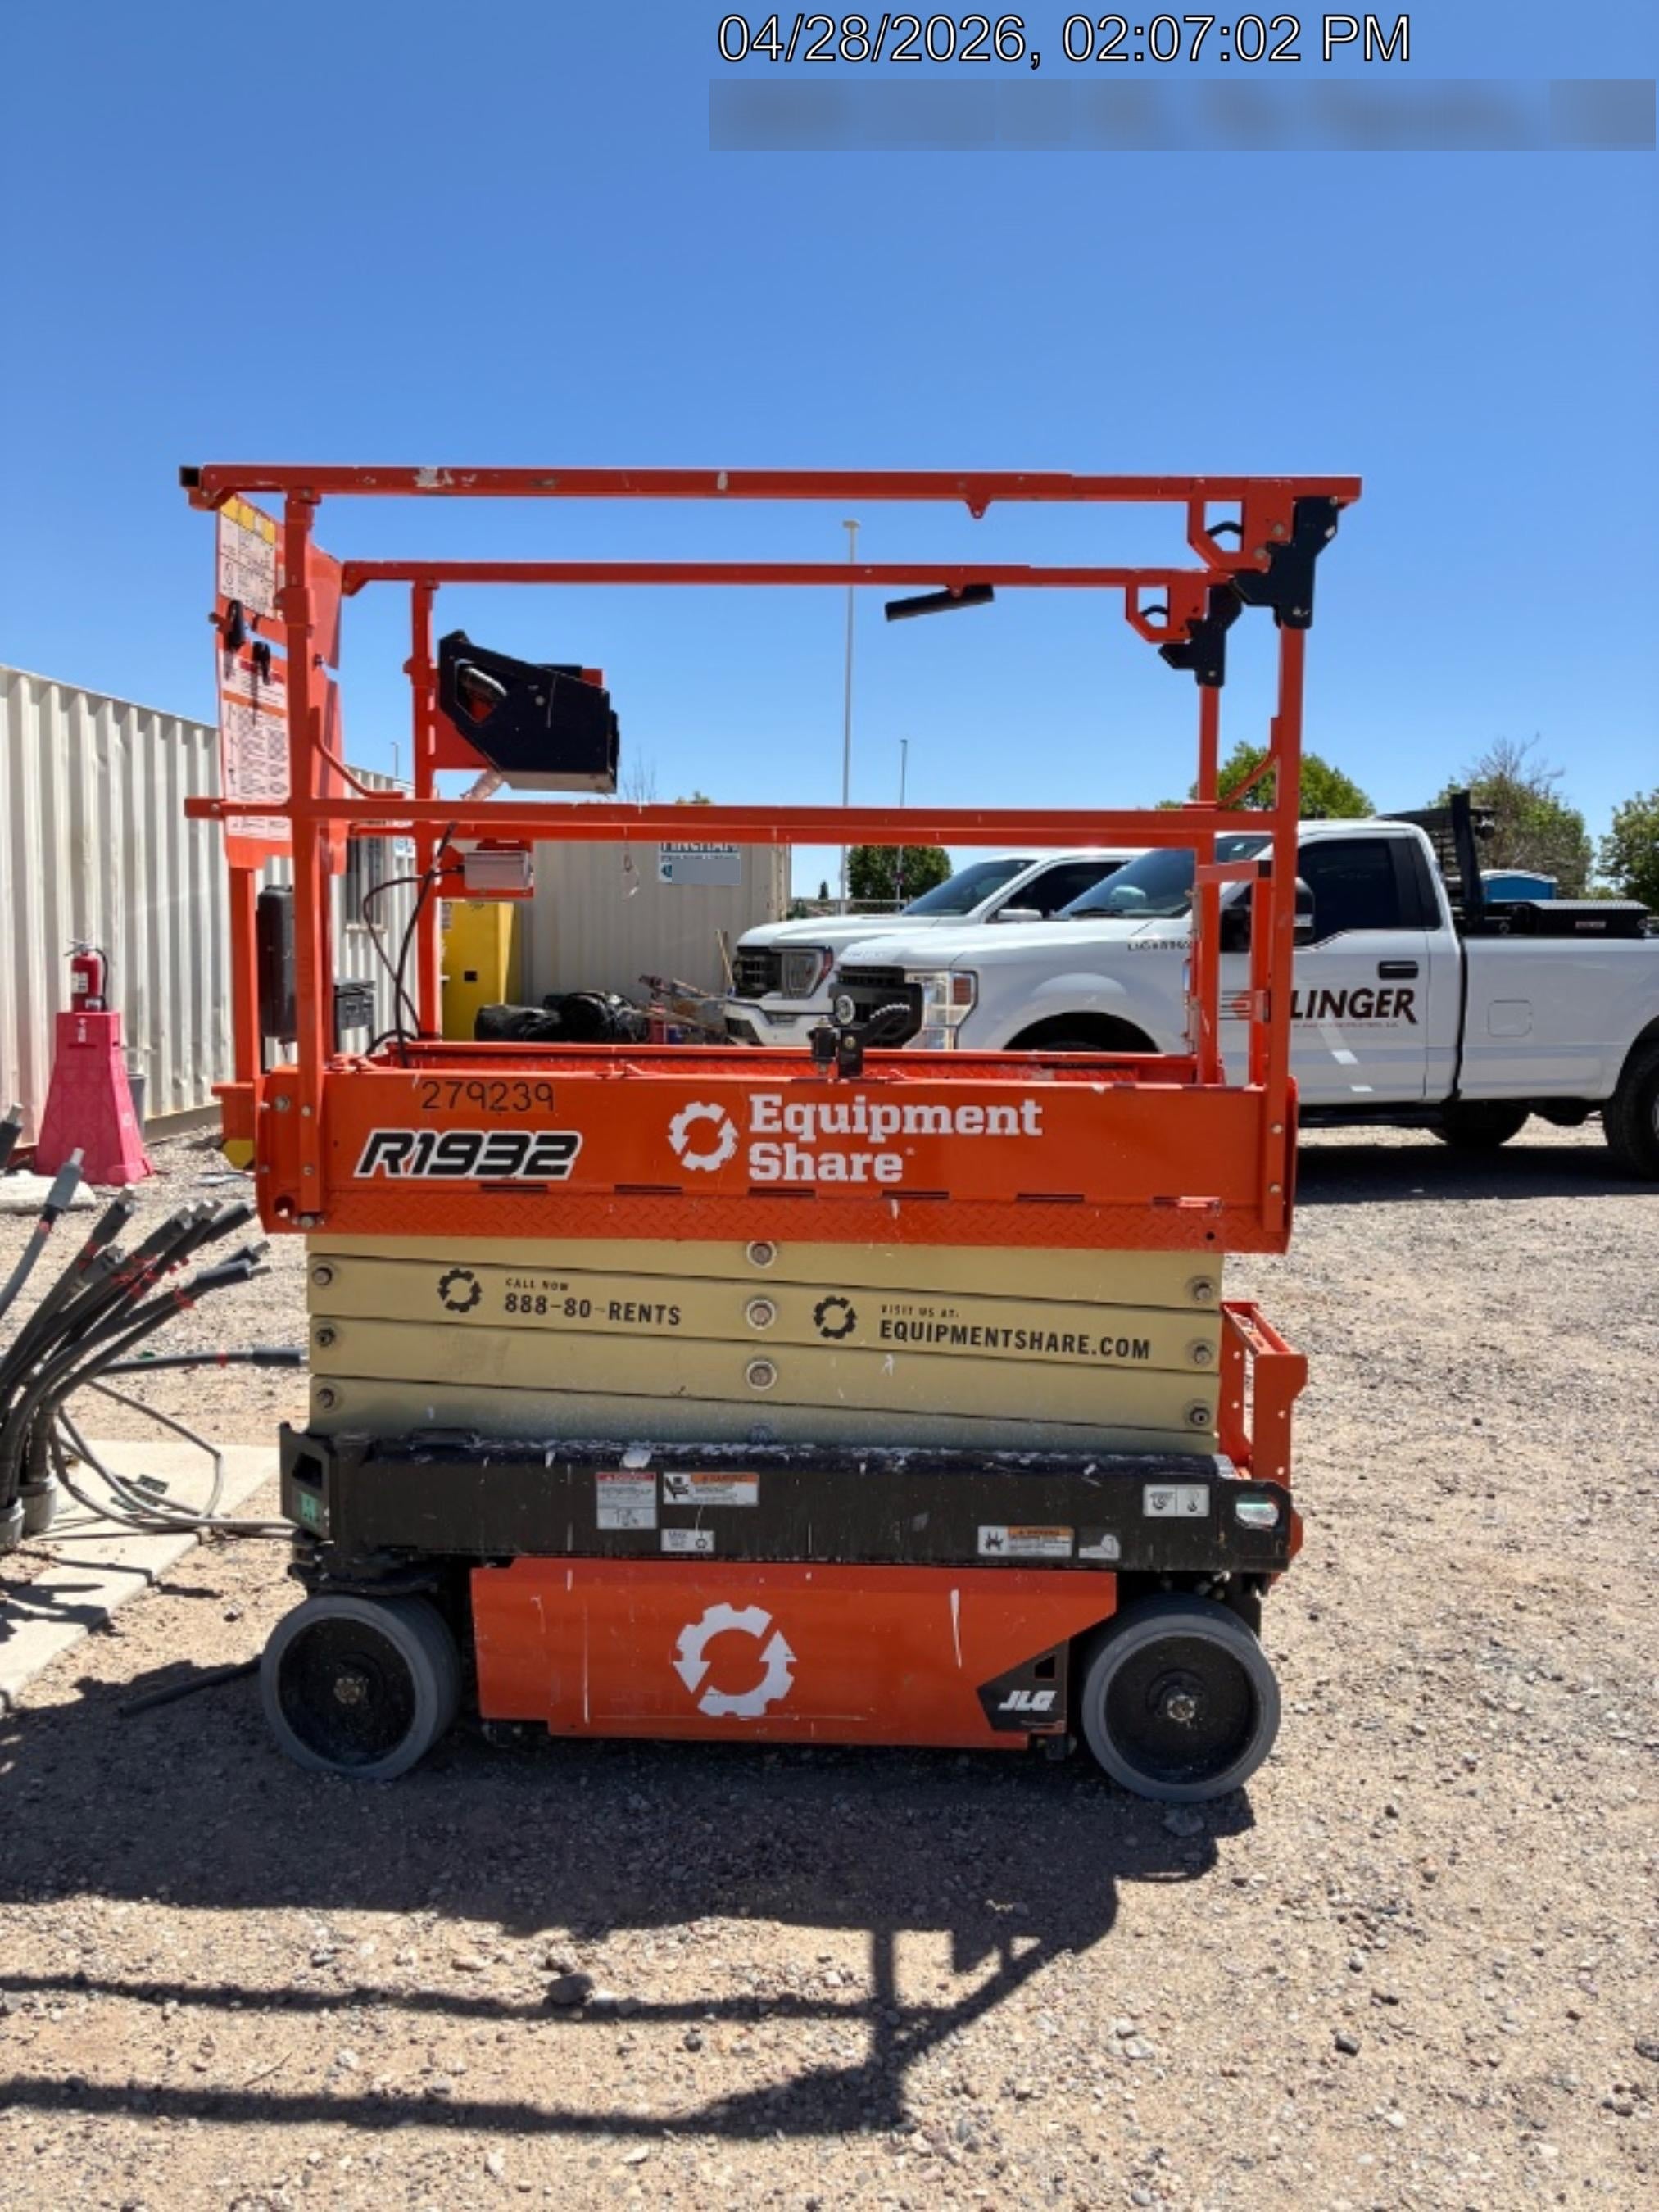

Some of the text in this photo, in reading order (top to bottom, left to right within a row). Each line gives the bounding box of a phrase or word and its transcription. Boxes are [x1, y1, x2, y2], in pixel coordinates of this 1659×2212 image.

[1290, 987, 1418, 1025] LINGER
[421, 1080, 555, 1113] 279239
[749, 1094, 1044, 1143] Equipment
[354, 1128, 582, 1180] R1932
[748, 1143, 903, 1182] Share
[505, 1277, 569, 1291] CALL NOW
[505, 1293, 682, 1326] 888-80-RENTS
[881, 1303, 913, 1316] VISIT
[918, 1307, 935, 1318] US
[879, 1320, 1152, 1360] EQUIPMENTSHARE.COM
[998, 1690, 1057, 1711] JLG
